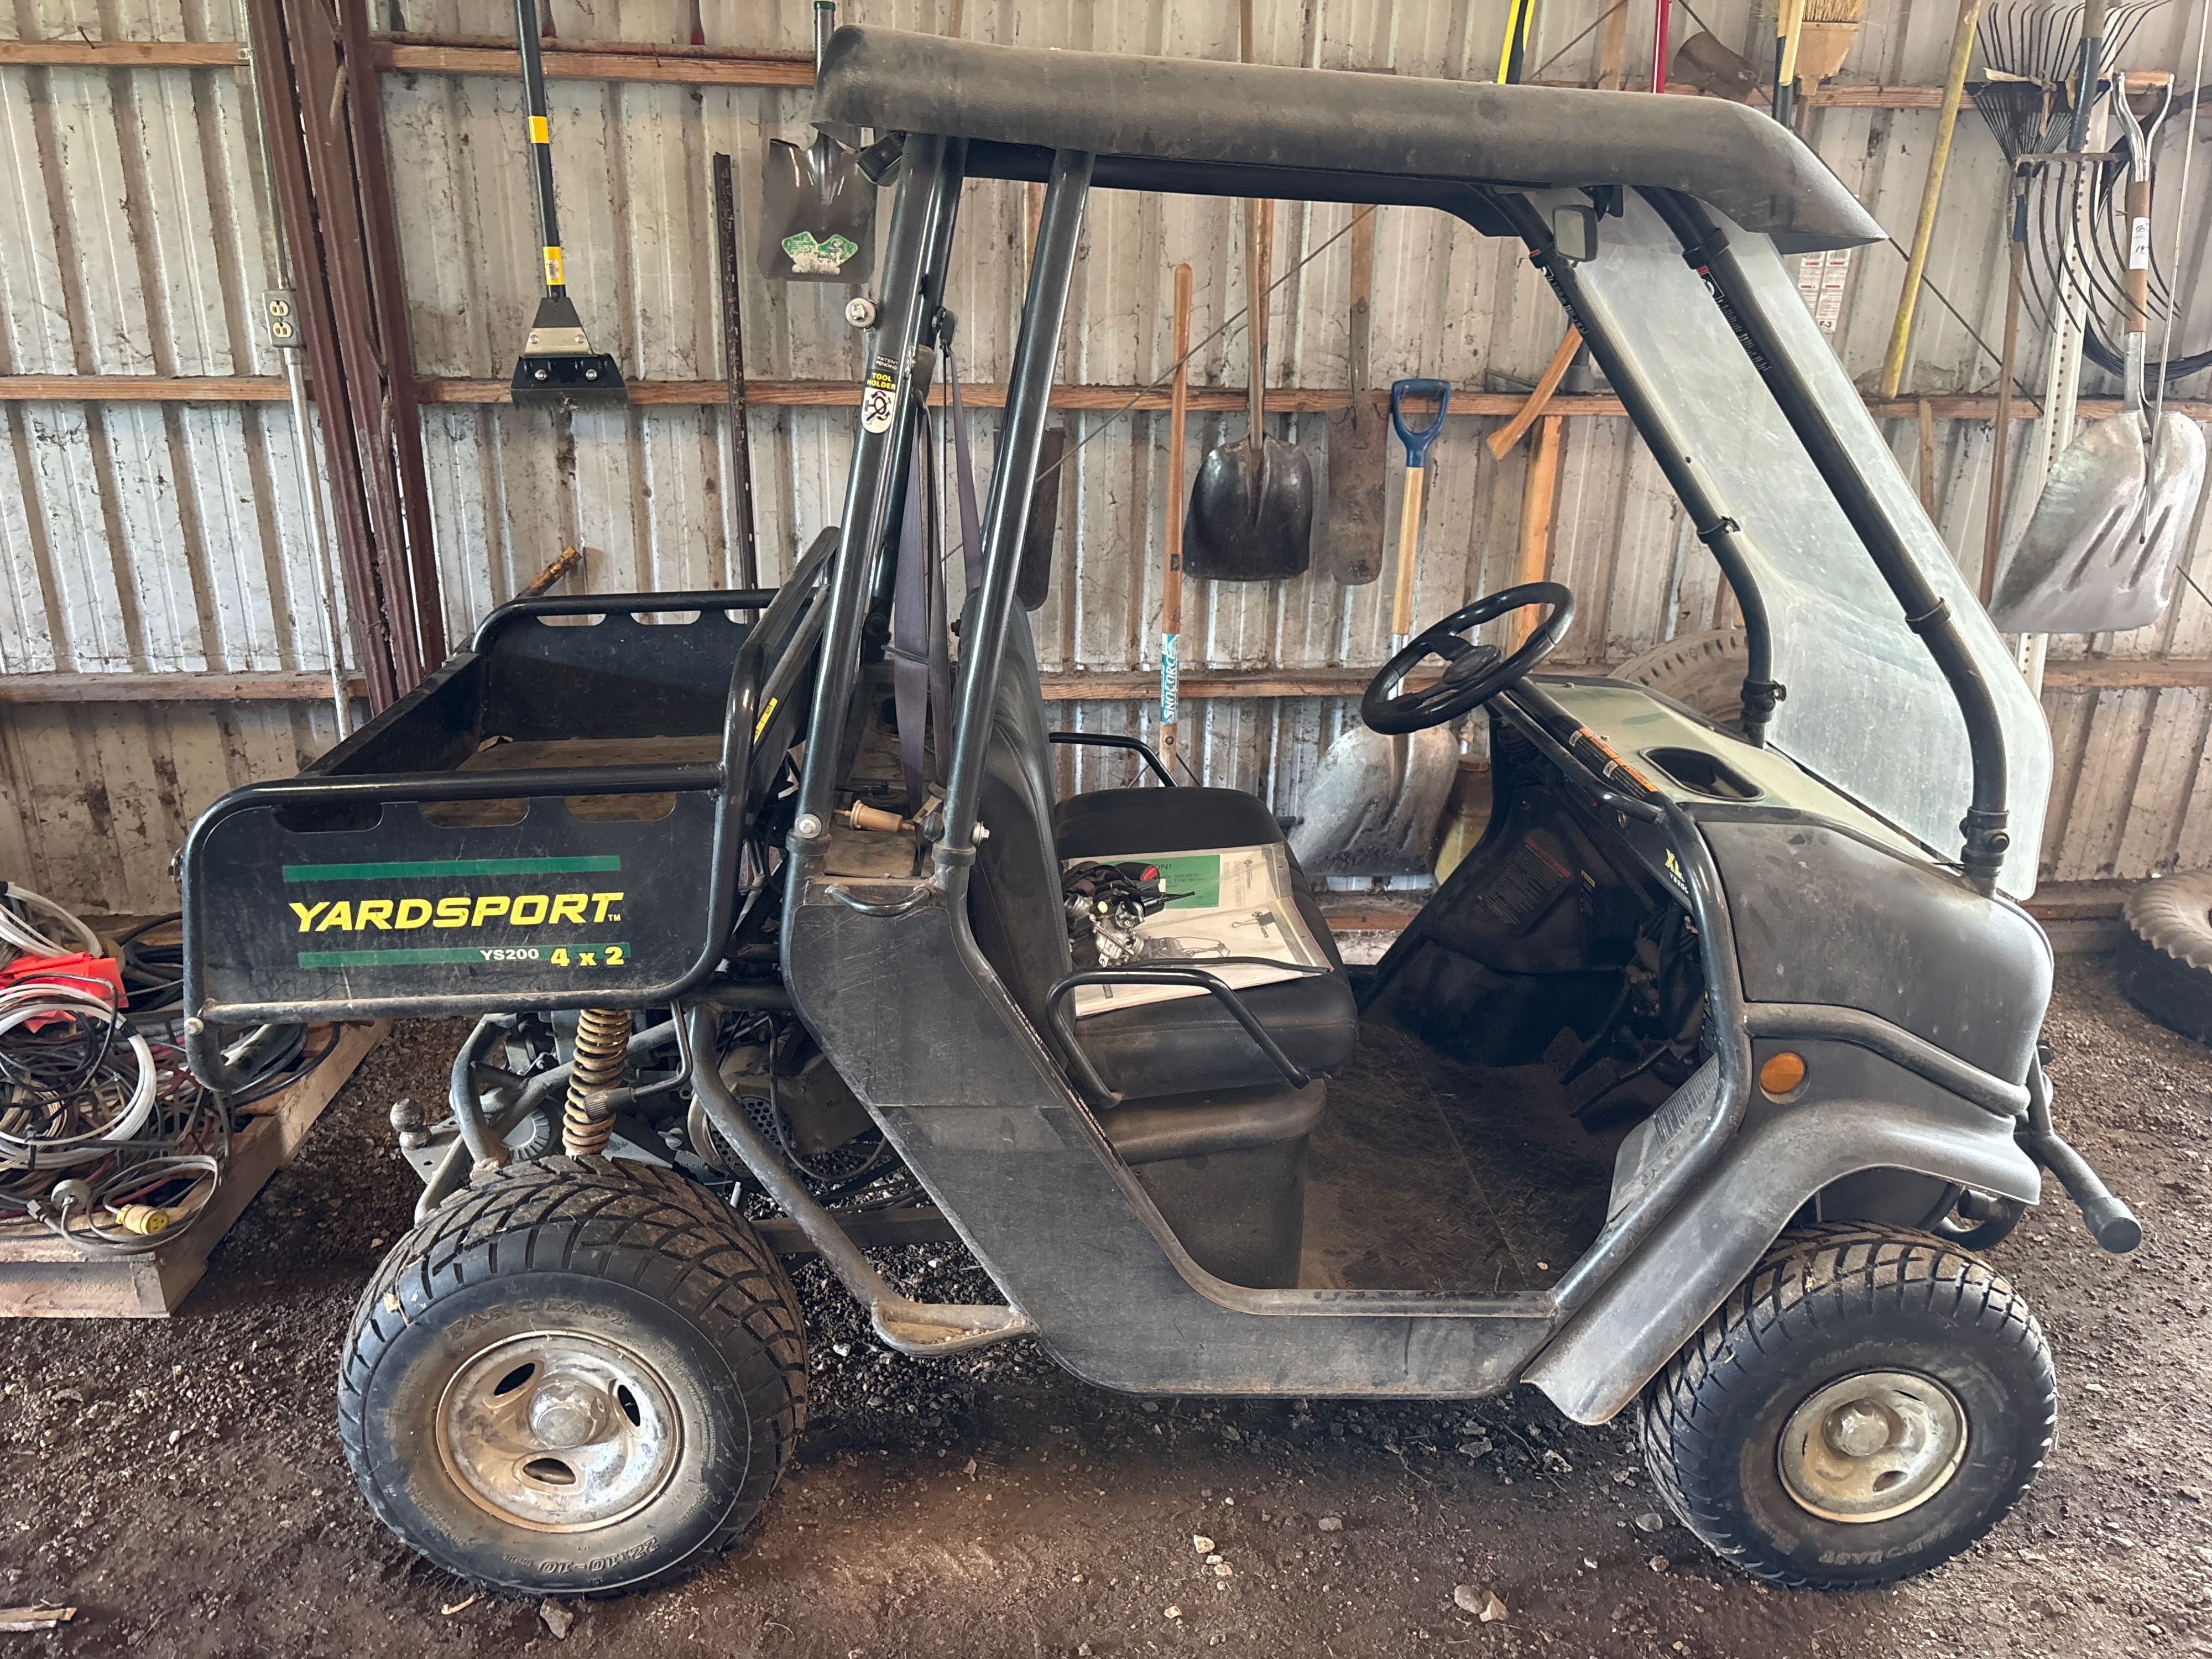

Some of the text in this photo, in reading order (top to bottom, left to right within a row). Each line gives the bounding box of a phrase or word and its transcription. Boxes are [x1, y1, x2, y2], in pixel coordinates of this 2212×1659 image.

[875, 361, 898, 370] PENDING
[877, 356, 898, 365] PATENT
[872, 372, 893, 382] TOOL
[867, 379, 896, 390] HOLDER
[288, 892, 624, 932] YARDSPORT
[479, 946, 624, 967] YS200 4 x 2
[545, 1300, 632, 1326] EAST
